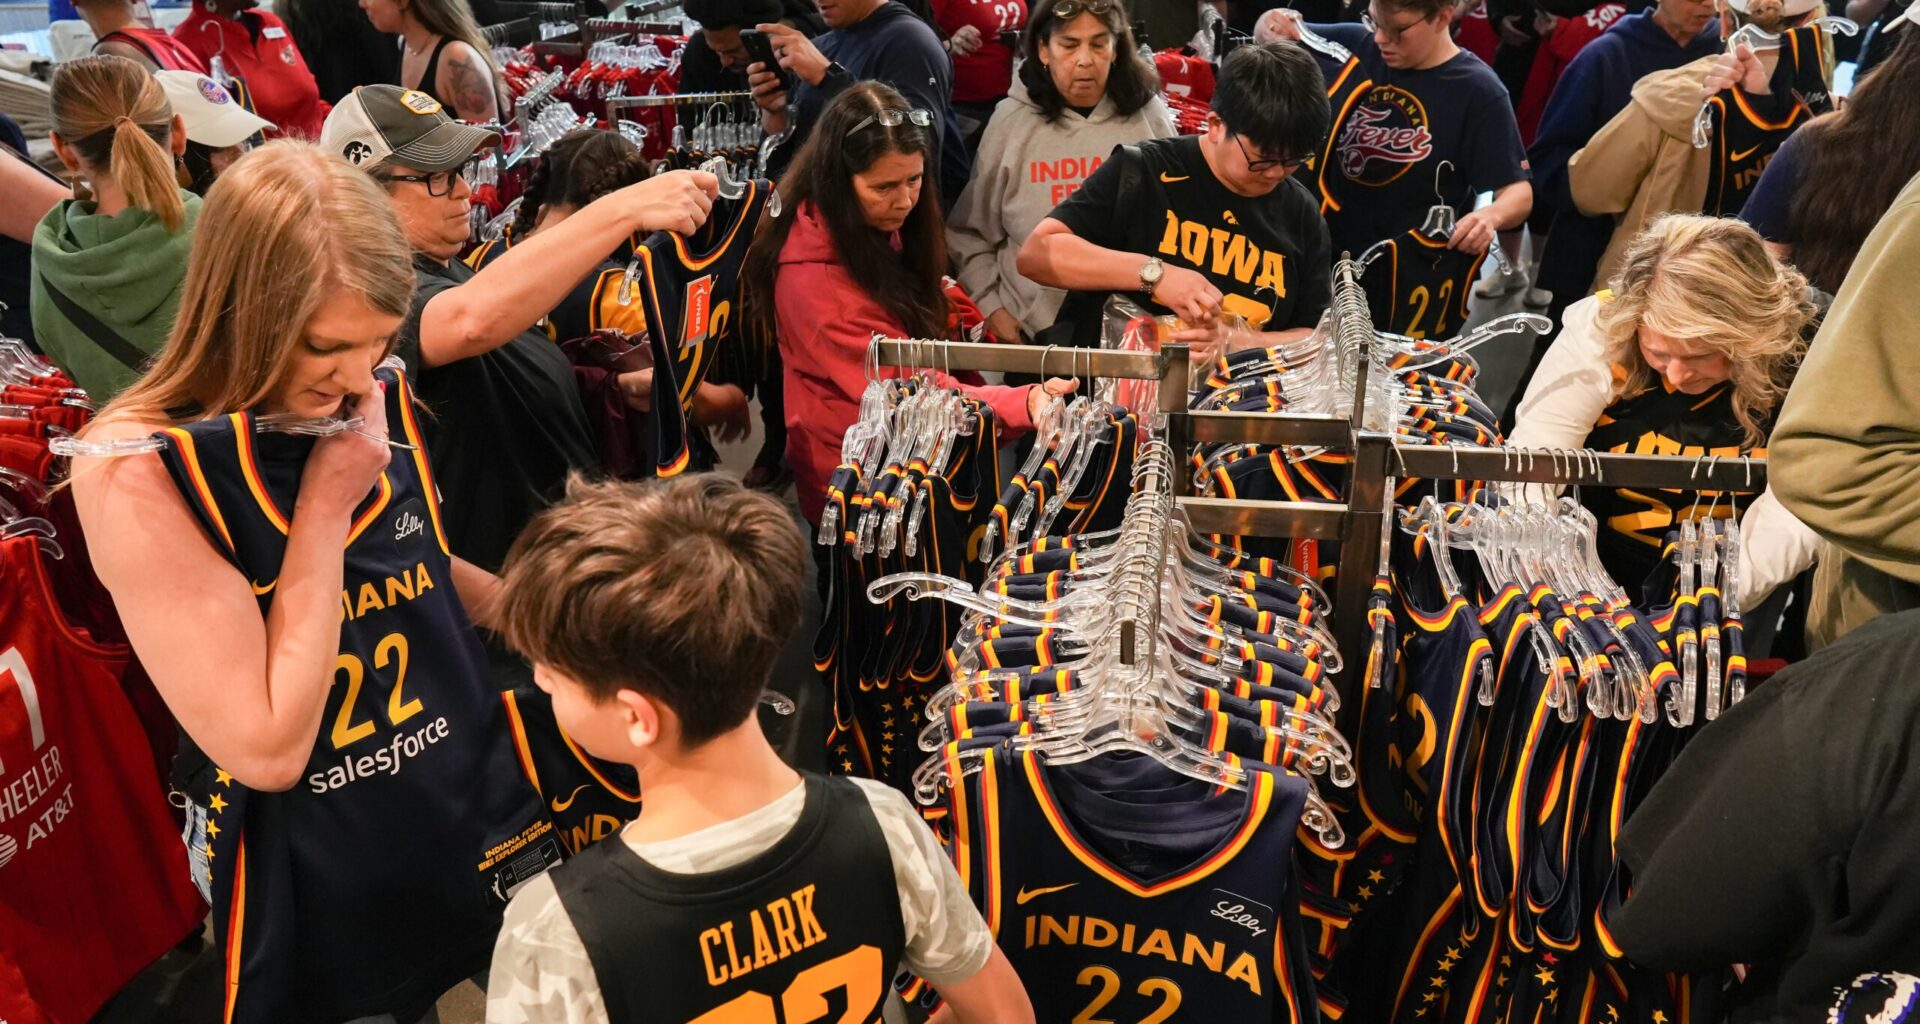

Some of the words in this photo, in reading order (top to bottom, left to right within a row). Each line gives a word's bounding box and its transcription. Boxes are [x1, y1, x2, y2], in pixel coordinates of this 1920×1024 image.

[1337, 105, 1432, 162] Fever
[1368, 92, 1420, 126] NDIANA
[1158, 209, 1286, 298] IOWA
[1405, 279, 1453, 340] 22
[395, 512, 424, 540] Lilly
[341, 562, 434, 625] IANA
[331, 632, 424, 750] 22
[309, 716, 449, 794] salesforce
[27, 783, 74, 850] AT&T
[485, 834, 521, 859] INDIANA
[522, 820, 543, 838] FEVER
[527, 821, 553, 842] EDITION
[699, 883, 828, 987] CLARK
[1210, 900, 1267, 937] Lilly
[1025, 914, 1262, 996] INDIANA
[1071, 966, 1182, 1024] 22
